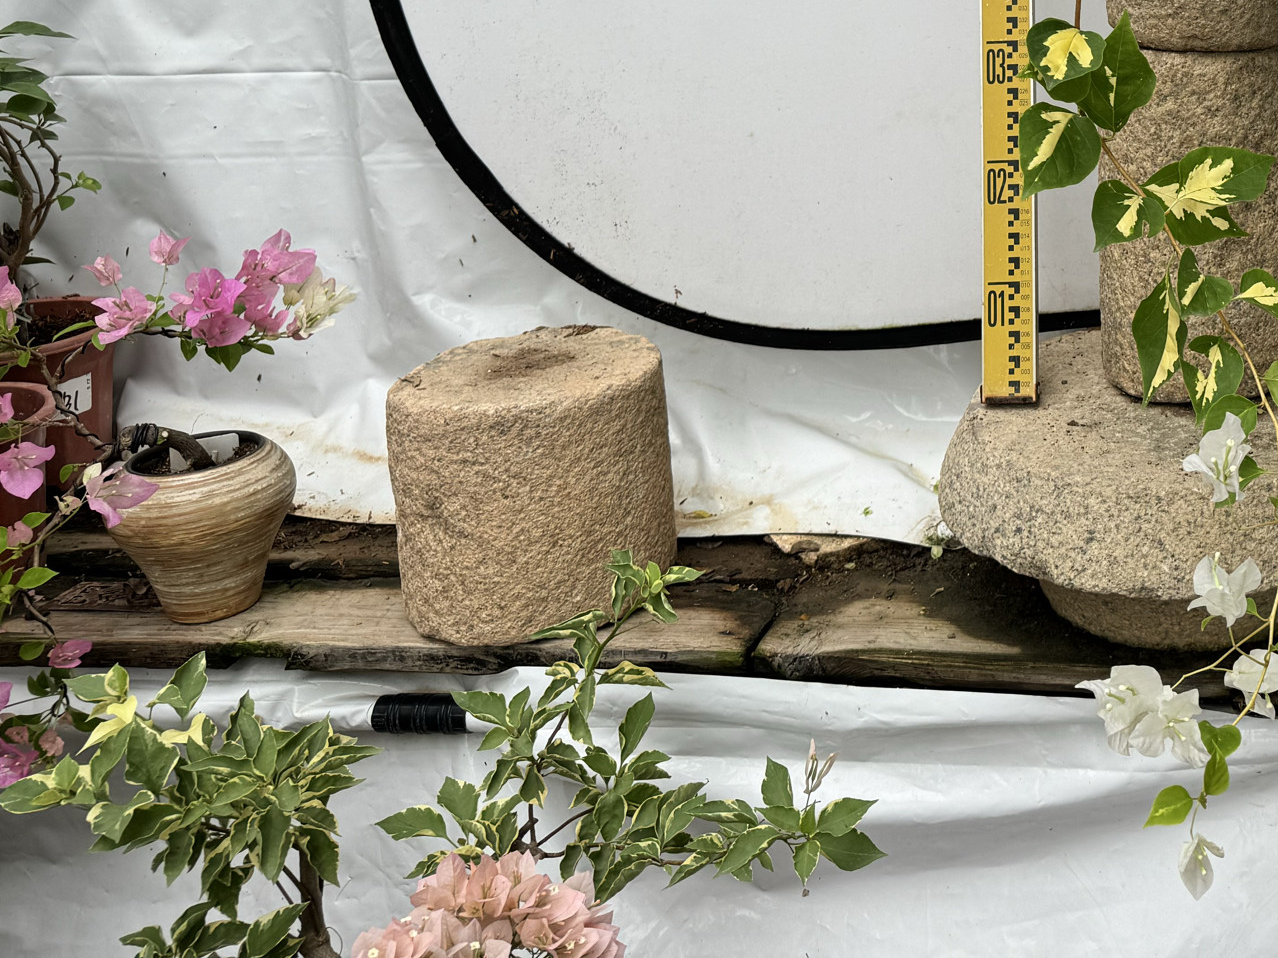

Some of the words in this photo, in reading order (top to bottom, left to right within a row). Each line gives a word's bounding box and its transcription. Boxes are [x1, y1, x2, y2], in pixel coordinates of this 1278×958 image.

[986, 48, 1006, 85] 03
[987, 168, 1007, 205] 02
[987, 290, 1005, 327] 01
